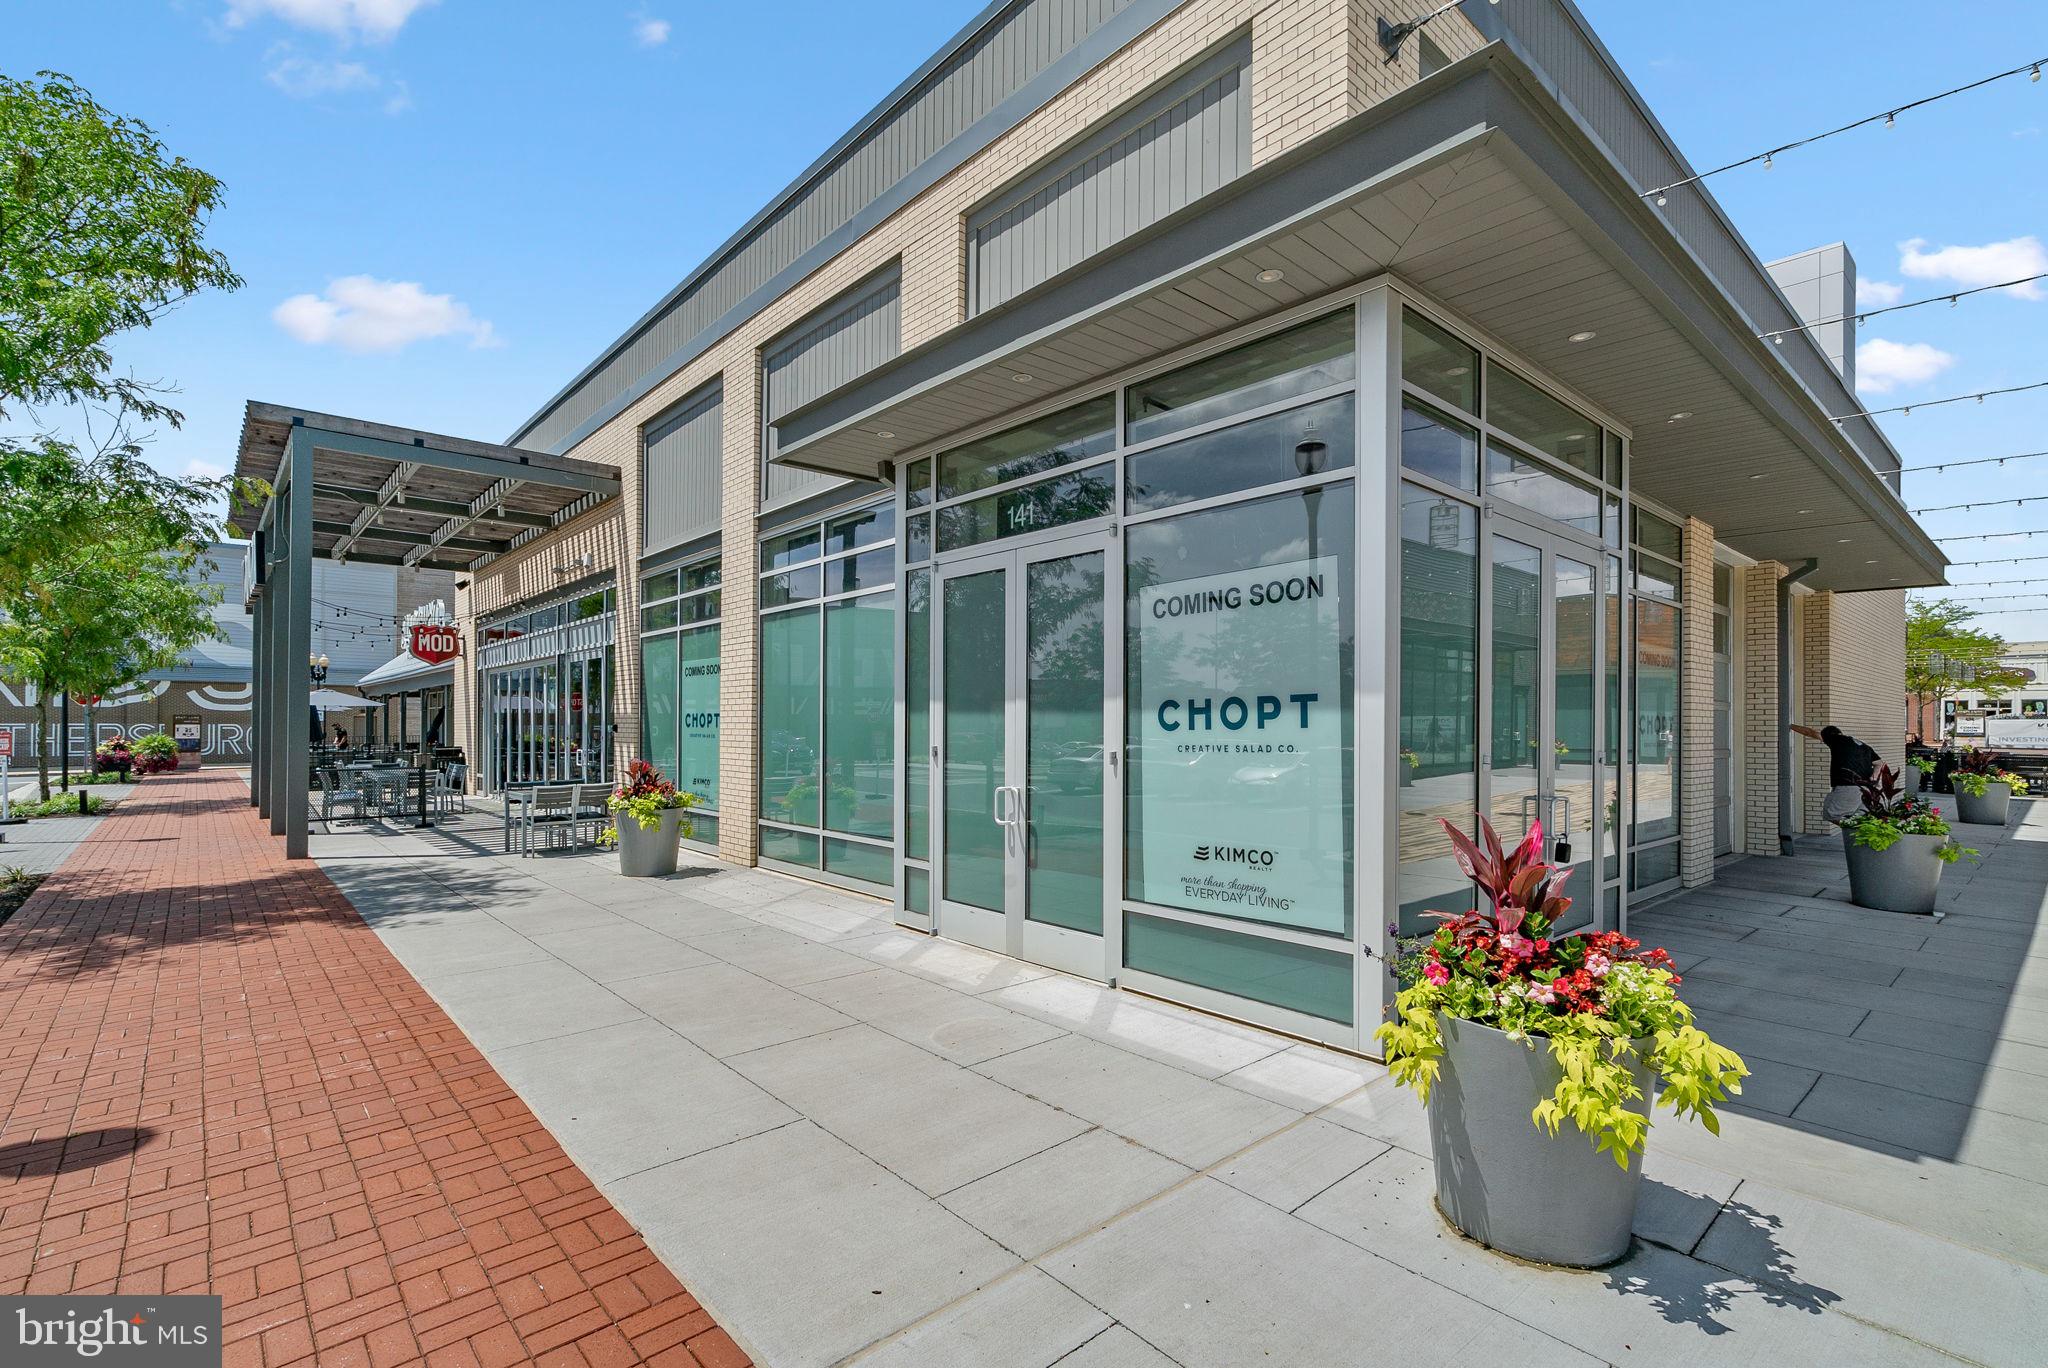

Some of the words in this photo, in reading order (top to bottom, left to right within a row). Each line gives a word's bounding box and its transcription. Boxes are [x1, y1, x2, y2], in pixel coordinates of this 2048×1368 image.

[1007, 501, 1034, 529] 141
[1152, 587, 1242, 619] COMING
[1249, 574, 1324, 606] SOON
[418, 633, 454, 652] MOD
[685, 666, 706, 677] COMING
[685, 713, 720, 728] CHOPT
[1157, 693, 1318, 731] CHOPT
[1177, 744, 1229, 753] CREATIVE
[1235, 744, 1272, 753] SALAD
[1277, 744, 1300, 753] CO.
[1214, 846, 1274, 866] KIMCO
[1180, 876, 1202, 886] more
[1203, 875, 1225, 888] than
[1227, 878, 1267, 897] shopping
[1185, 885, 1245, 903] EVERYDAY
